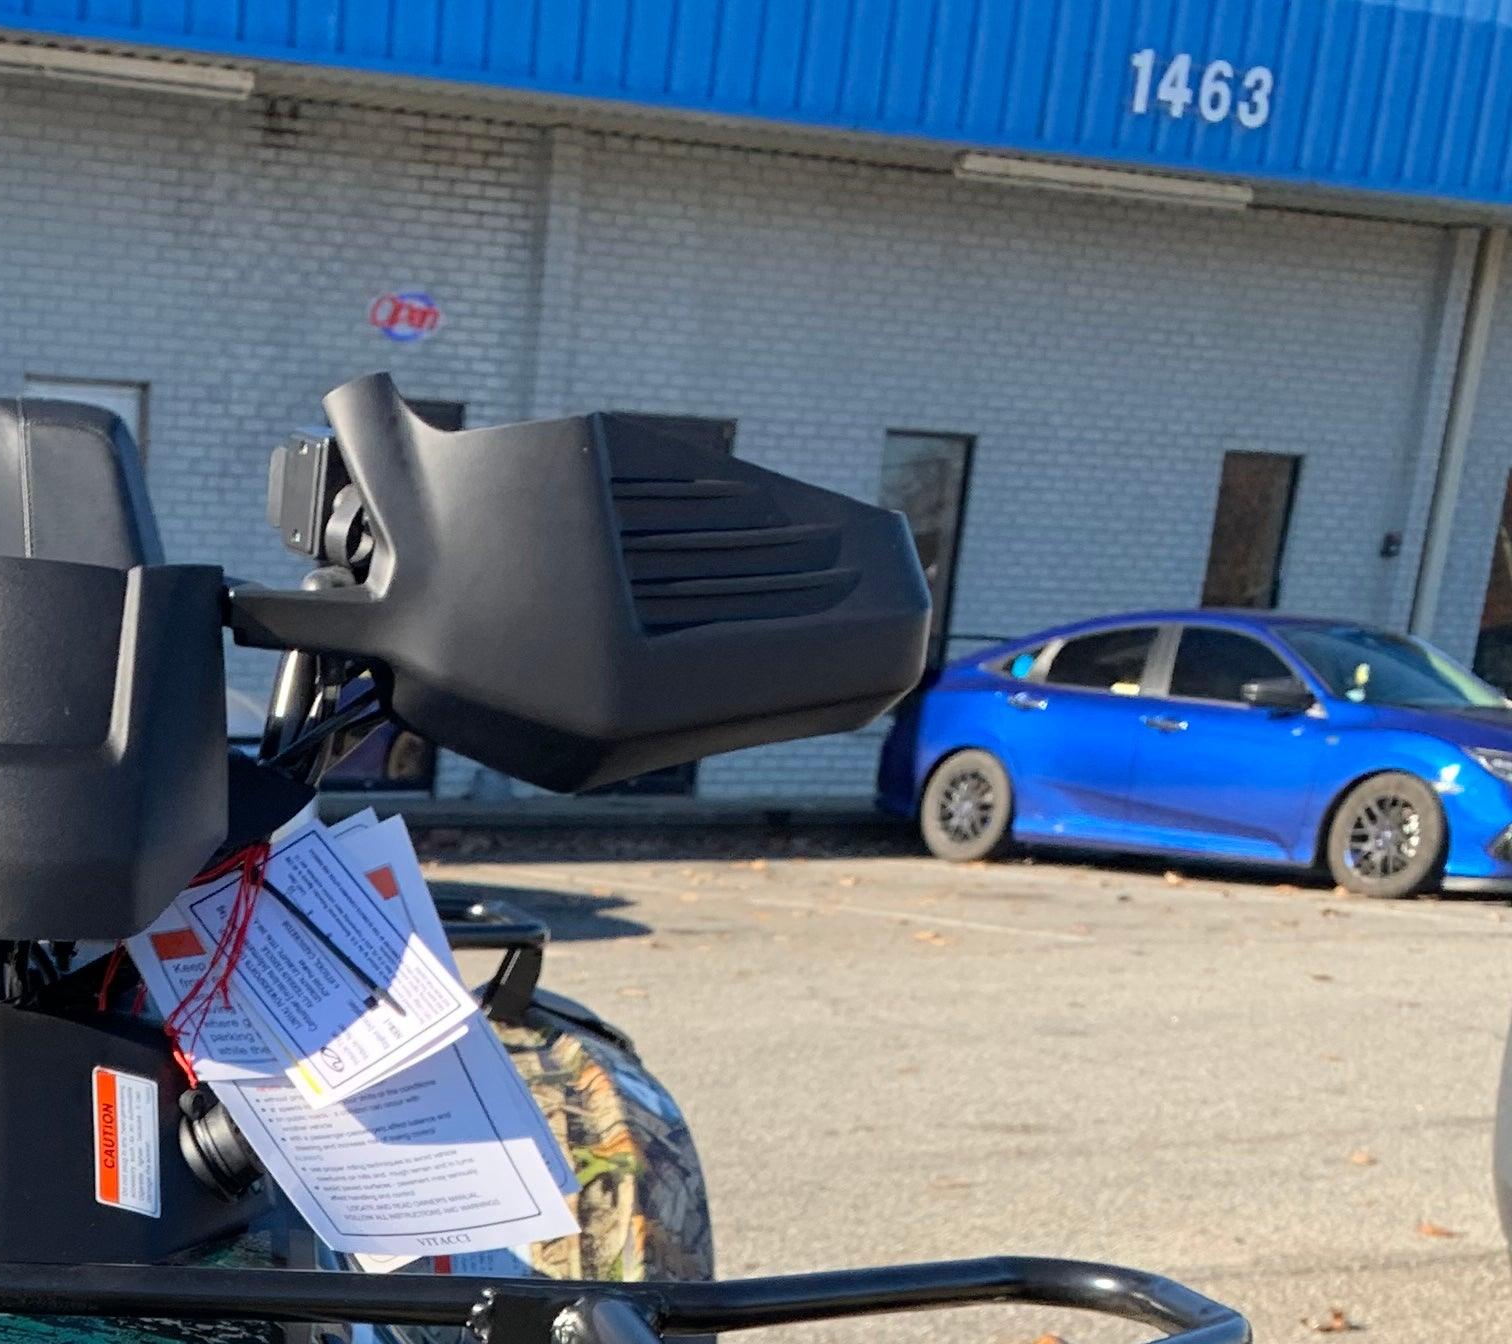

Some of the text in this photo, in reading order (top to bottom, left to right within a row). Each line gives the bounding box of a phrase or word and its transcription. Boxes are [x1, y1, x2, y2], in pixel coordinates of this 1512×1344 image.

[1130, 48, 1273, 128] 1463
[103, 1103, 116, 1169] CAUTION
[415, 1233, 472, 1247] VITACCI
